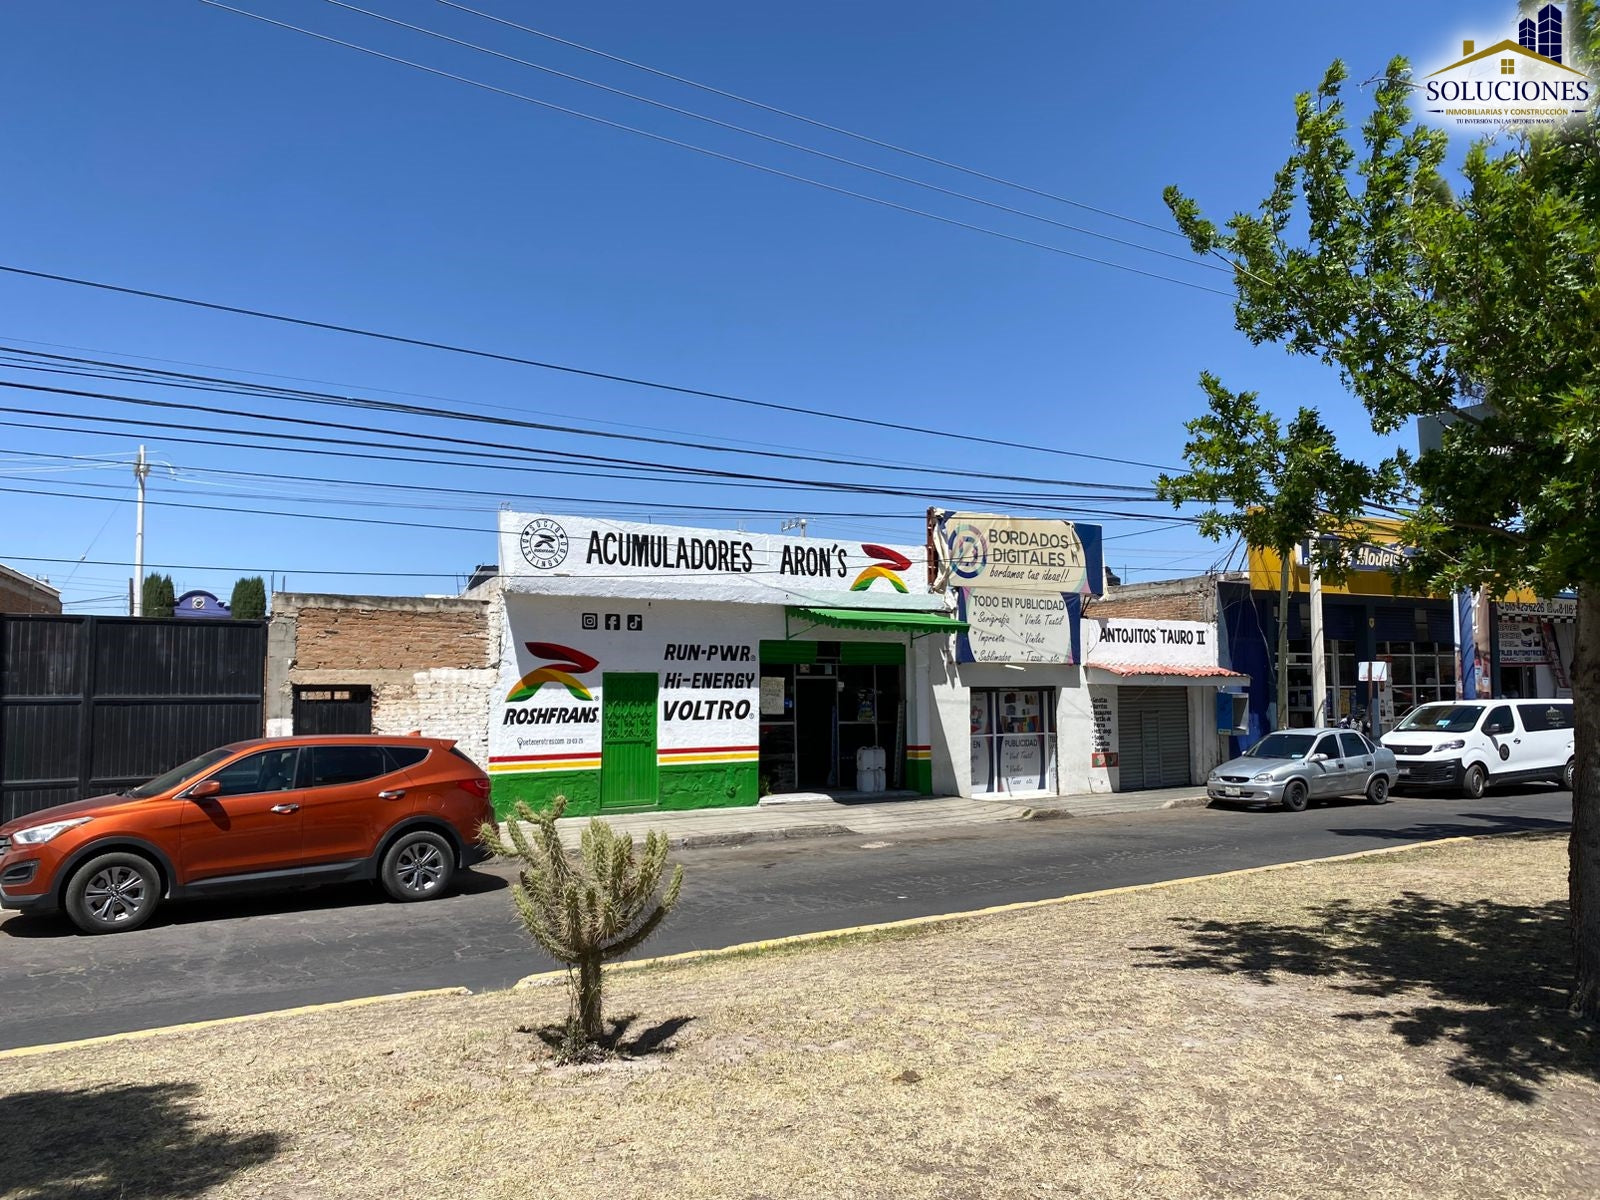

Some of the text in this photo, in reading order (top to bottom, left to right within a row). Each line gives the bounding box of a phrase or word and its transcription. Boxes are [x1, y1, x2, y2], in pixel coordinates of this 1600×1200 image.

[529, 520, 561, 533] SOCIO
[988, 528, 1069, 549] BORDADOS
[586, 530, 847, 578] ACUMULADORES ARON'S
[992, 548, 1066, 567] DIGITALES
[989, 564, 1025, 578] bordamos
[973, 595, 1065, 611] TODO EN PUBLICIDAD
[1043, 614, 1064, 626] Textil
[1099, 627, 1156, 643] ANTOJITOS
[663, 643, 751, 661] RUN-PWR
[664, 672, 755, 689] Hi-ENERGY
[503, 707, 599, 725] ROSHFRANS
[663, 699, 751, 721] VOLTRO
[1004, 739, 1038, 748] PUBLICIDAD
